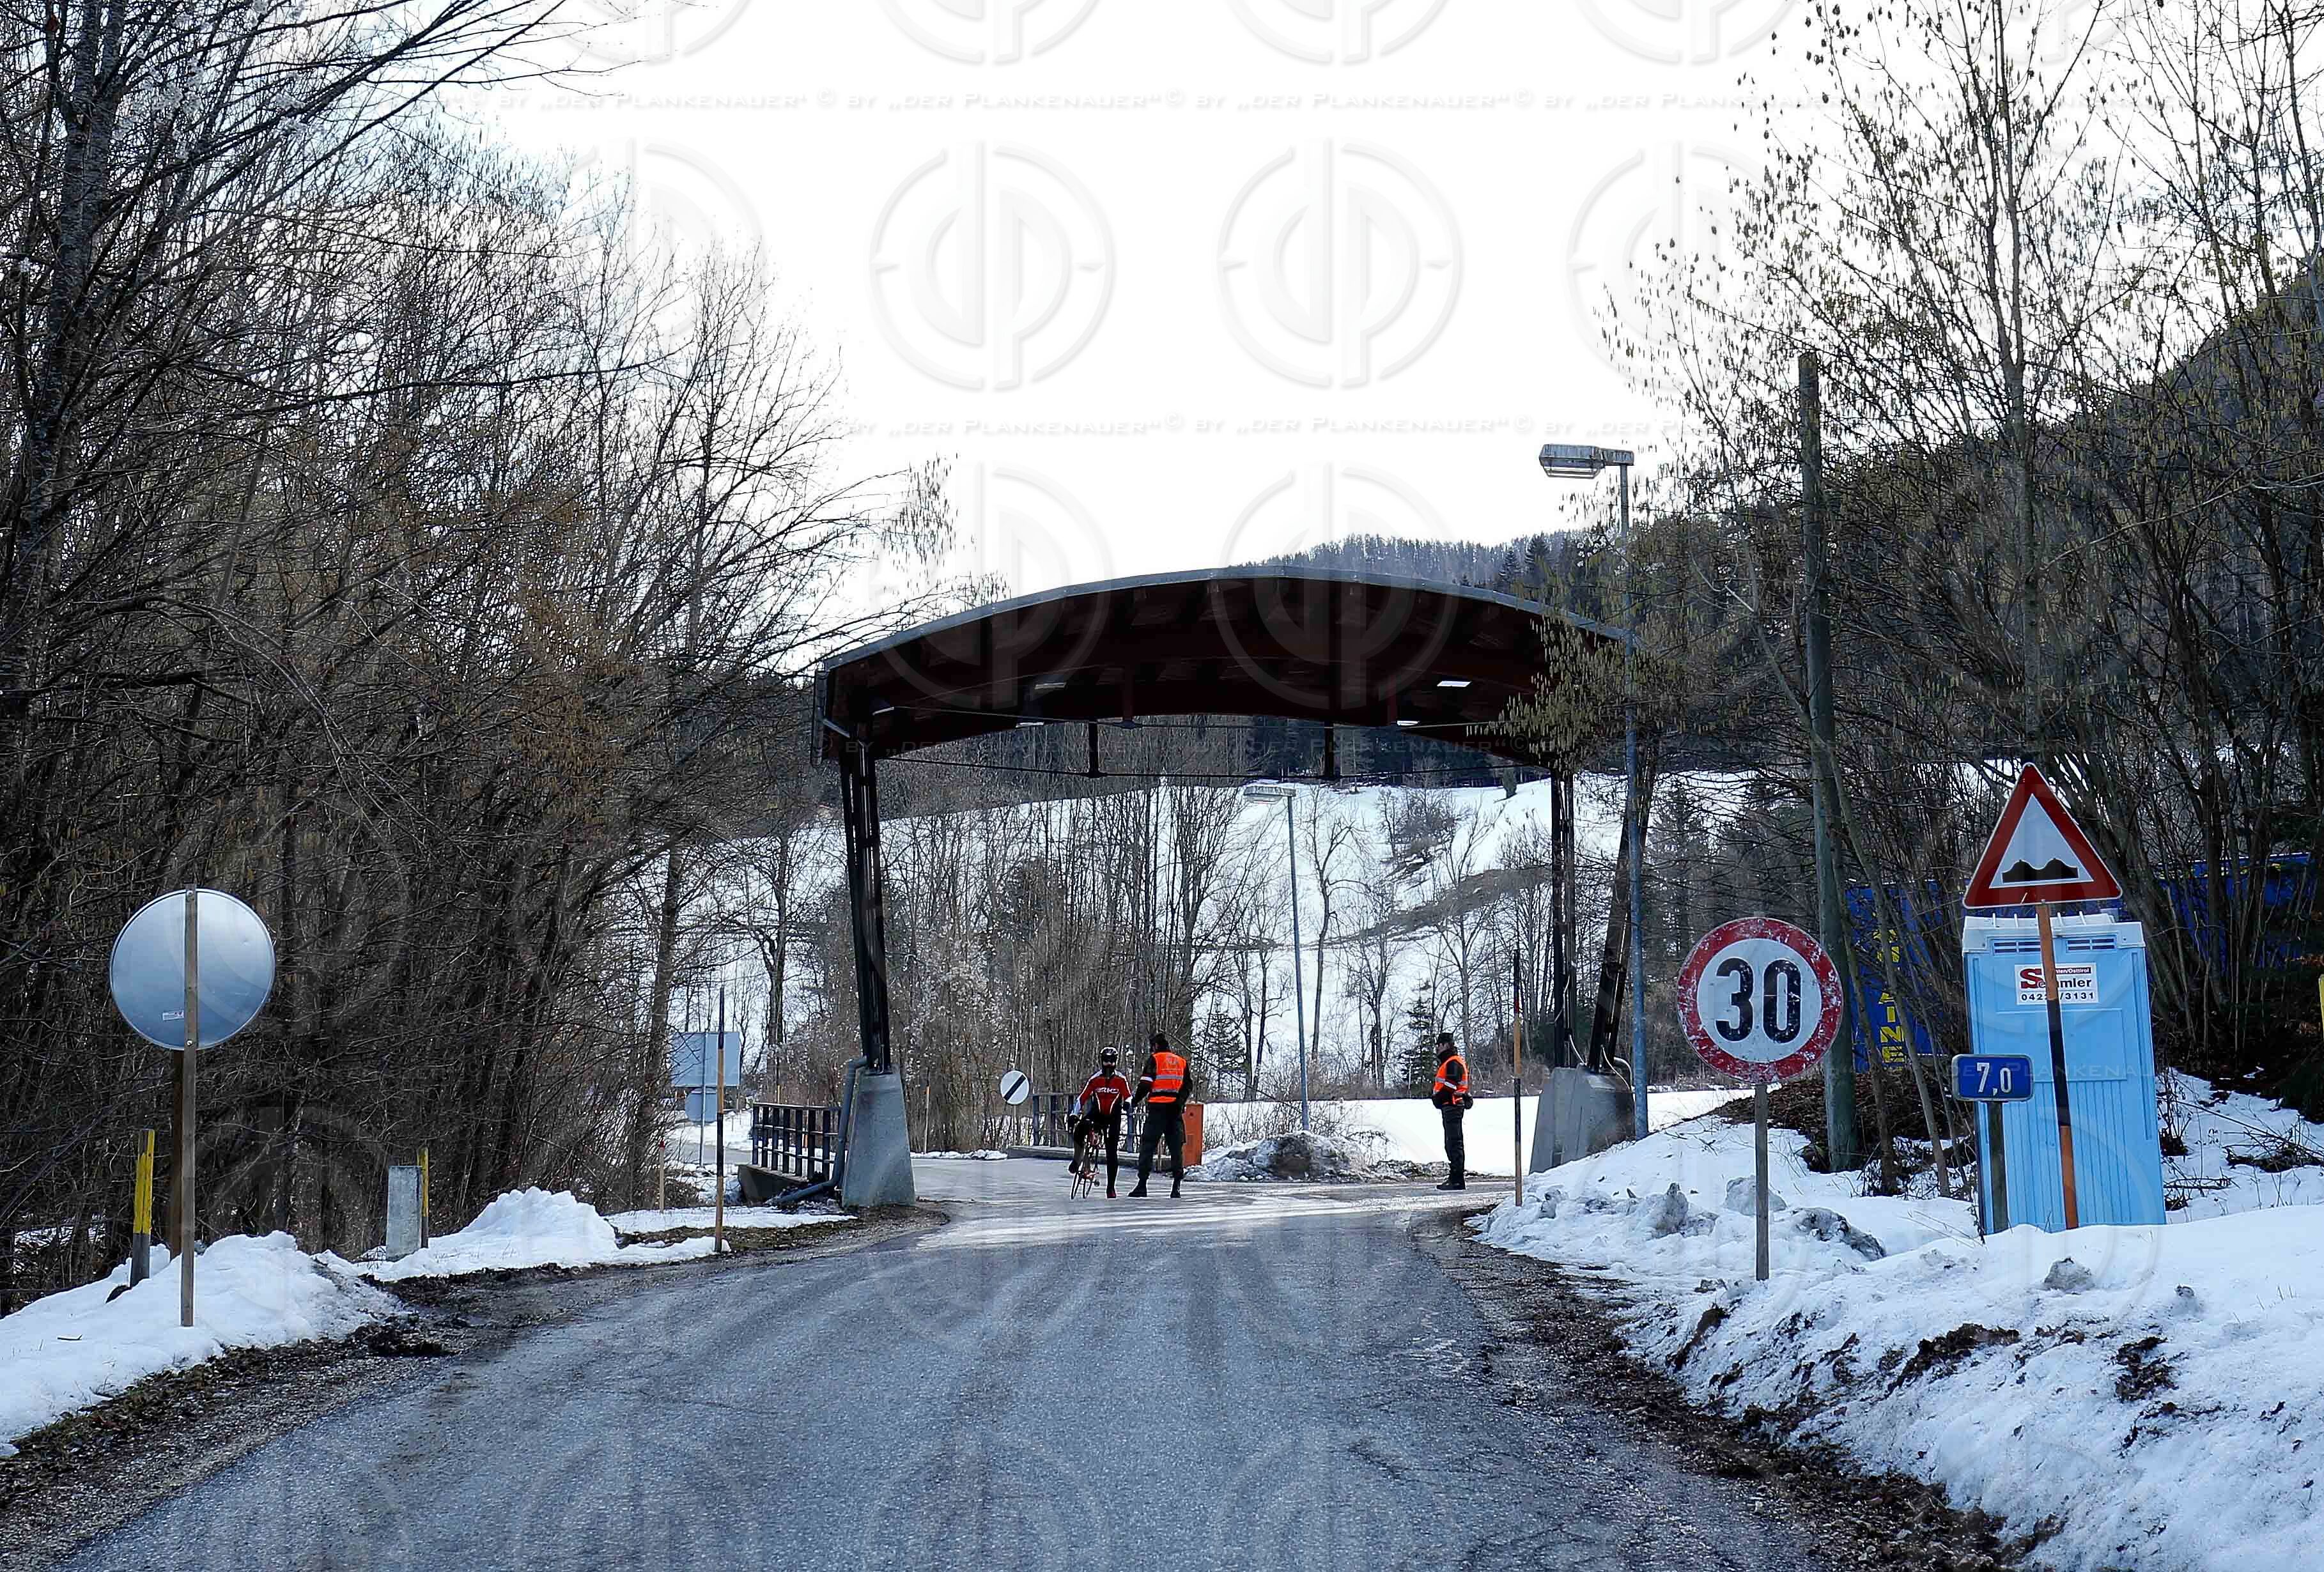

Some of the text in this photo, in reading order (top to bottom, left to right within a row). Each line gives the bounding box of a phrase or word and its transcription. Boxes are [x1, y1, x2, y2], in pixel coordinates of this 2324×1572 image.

[2020, 968, 2092, 989] Semler
[1716, 957, 1802, 1044] 30
[2021, 992, 2094, 1001] 042/3131
[1976, 1062, 2012, 1096] 7,0
